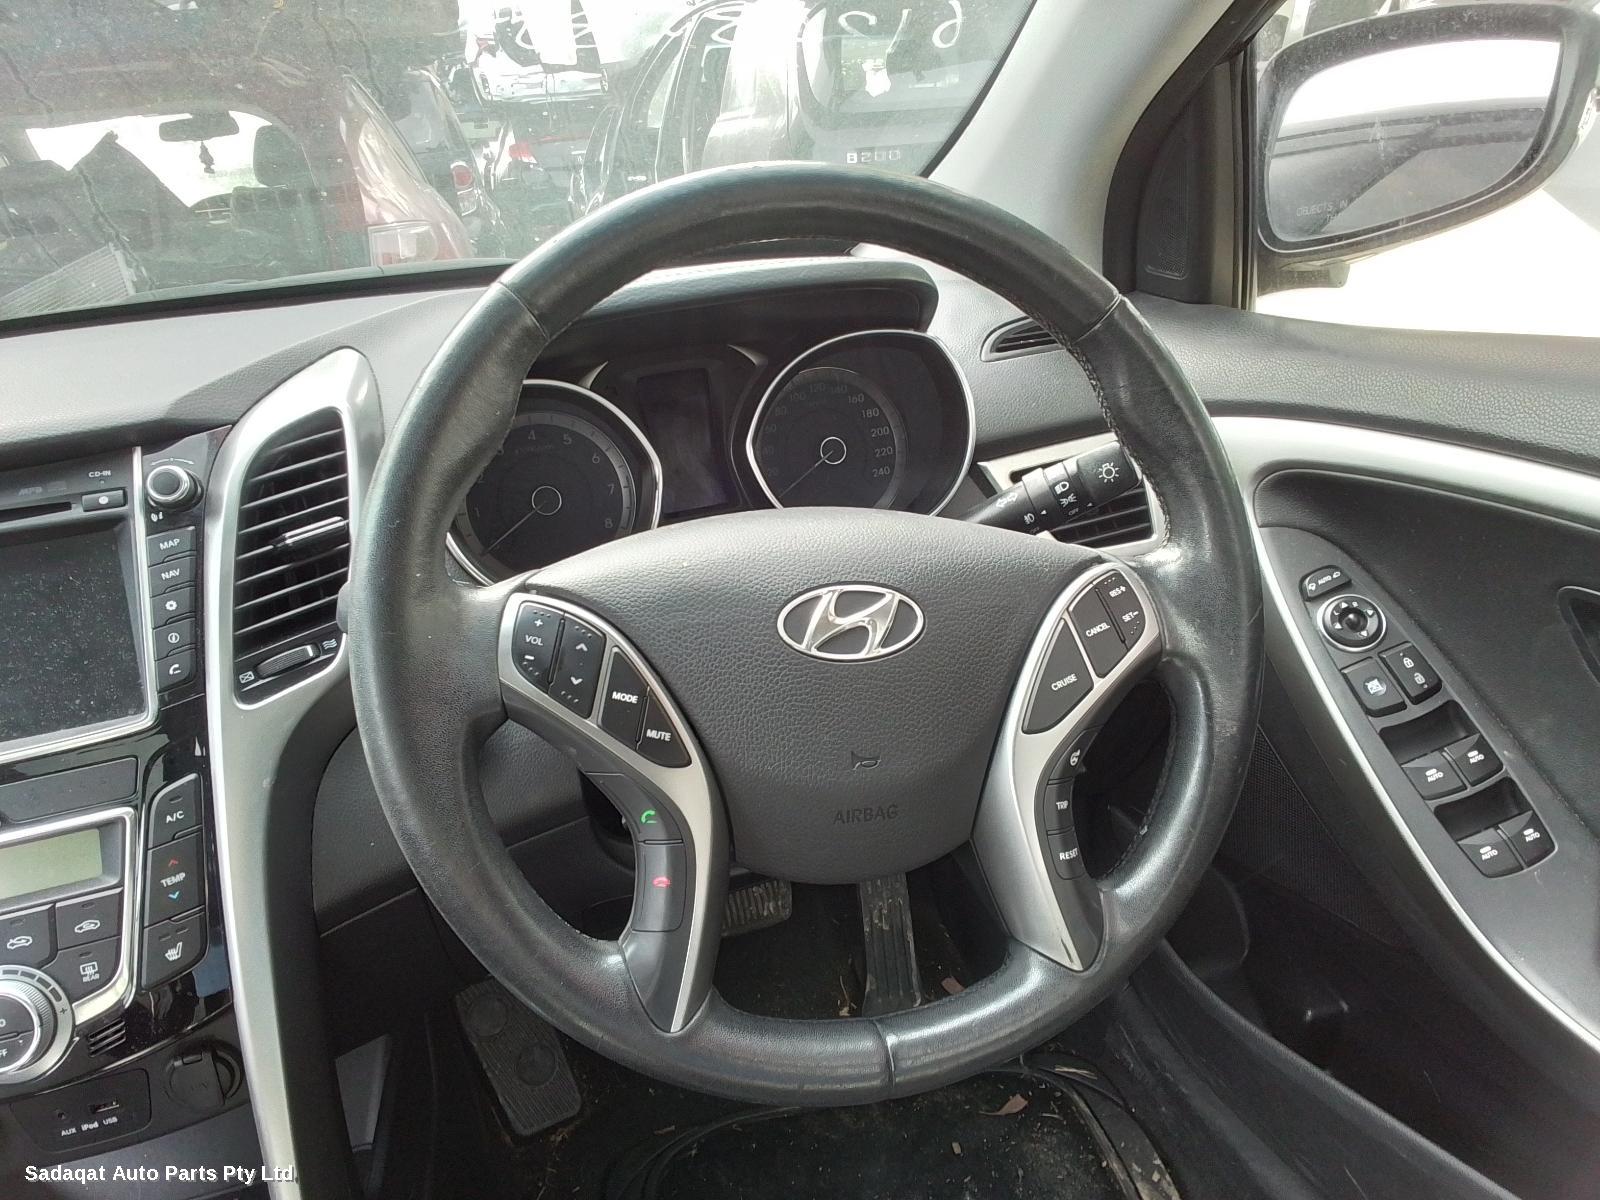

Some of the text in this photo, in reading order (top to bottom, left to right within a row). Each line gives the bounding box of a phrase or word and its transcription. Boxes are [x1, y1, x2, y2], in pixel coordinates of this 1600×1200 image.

[1296, 201, 1334, 217] OBJECTS
[848, 393, 865, 404] 160
[862, 407, 880, 419] 180
[528, 429, 536, 441] 4
[870, 426, 890, 438] 200
[562, 433, 573, 446] 5
[591, 451, 601, 465] 6
[874, 446, 893, 458] 220
[88, 470, 112, 478] CD-IN
[872, 466, 891, 478] 240
[607, 483, 616, 496] 7
[604, 518, 614, 529] 8
[159, 538, 181, 550] MAP
[161, 568, 181, 581] NAV
[1085, 622, 1111, 638] CANCEL
[525, 634, 544, 647] VOL
[1051, 673, 1078, 692] CRUISE
[612, 690, 639, 705] MODE
[646, 728, 672, 743] MUTE
[1469, 753, 1485, 764] AUTO
[1427, 771, 1444, 783] AUTO
[165, 810, 185, 824] A/C
[833, 803, 898, 825] AIRBAG
[1525, 831, 1541, 843] AUTO
[1059, 848, 1079, 861] RESET
[1481, 849, 1499, 861] AUTO
[160, 872, 186, 888] TEMP
[61, 1116, 118, 1137] AUX iPod USB
